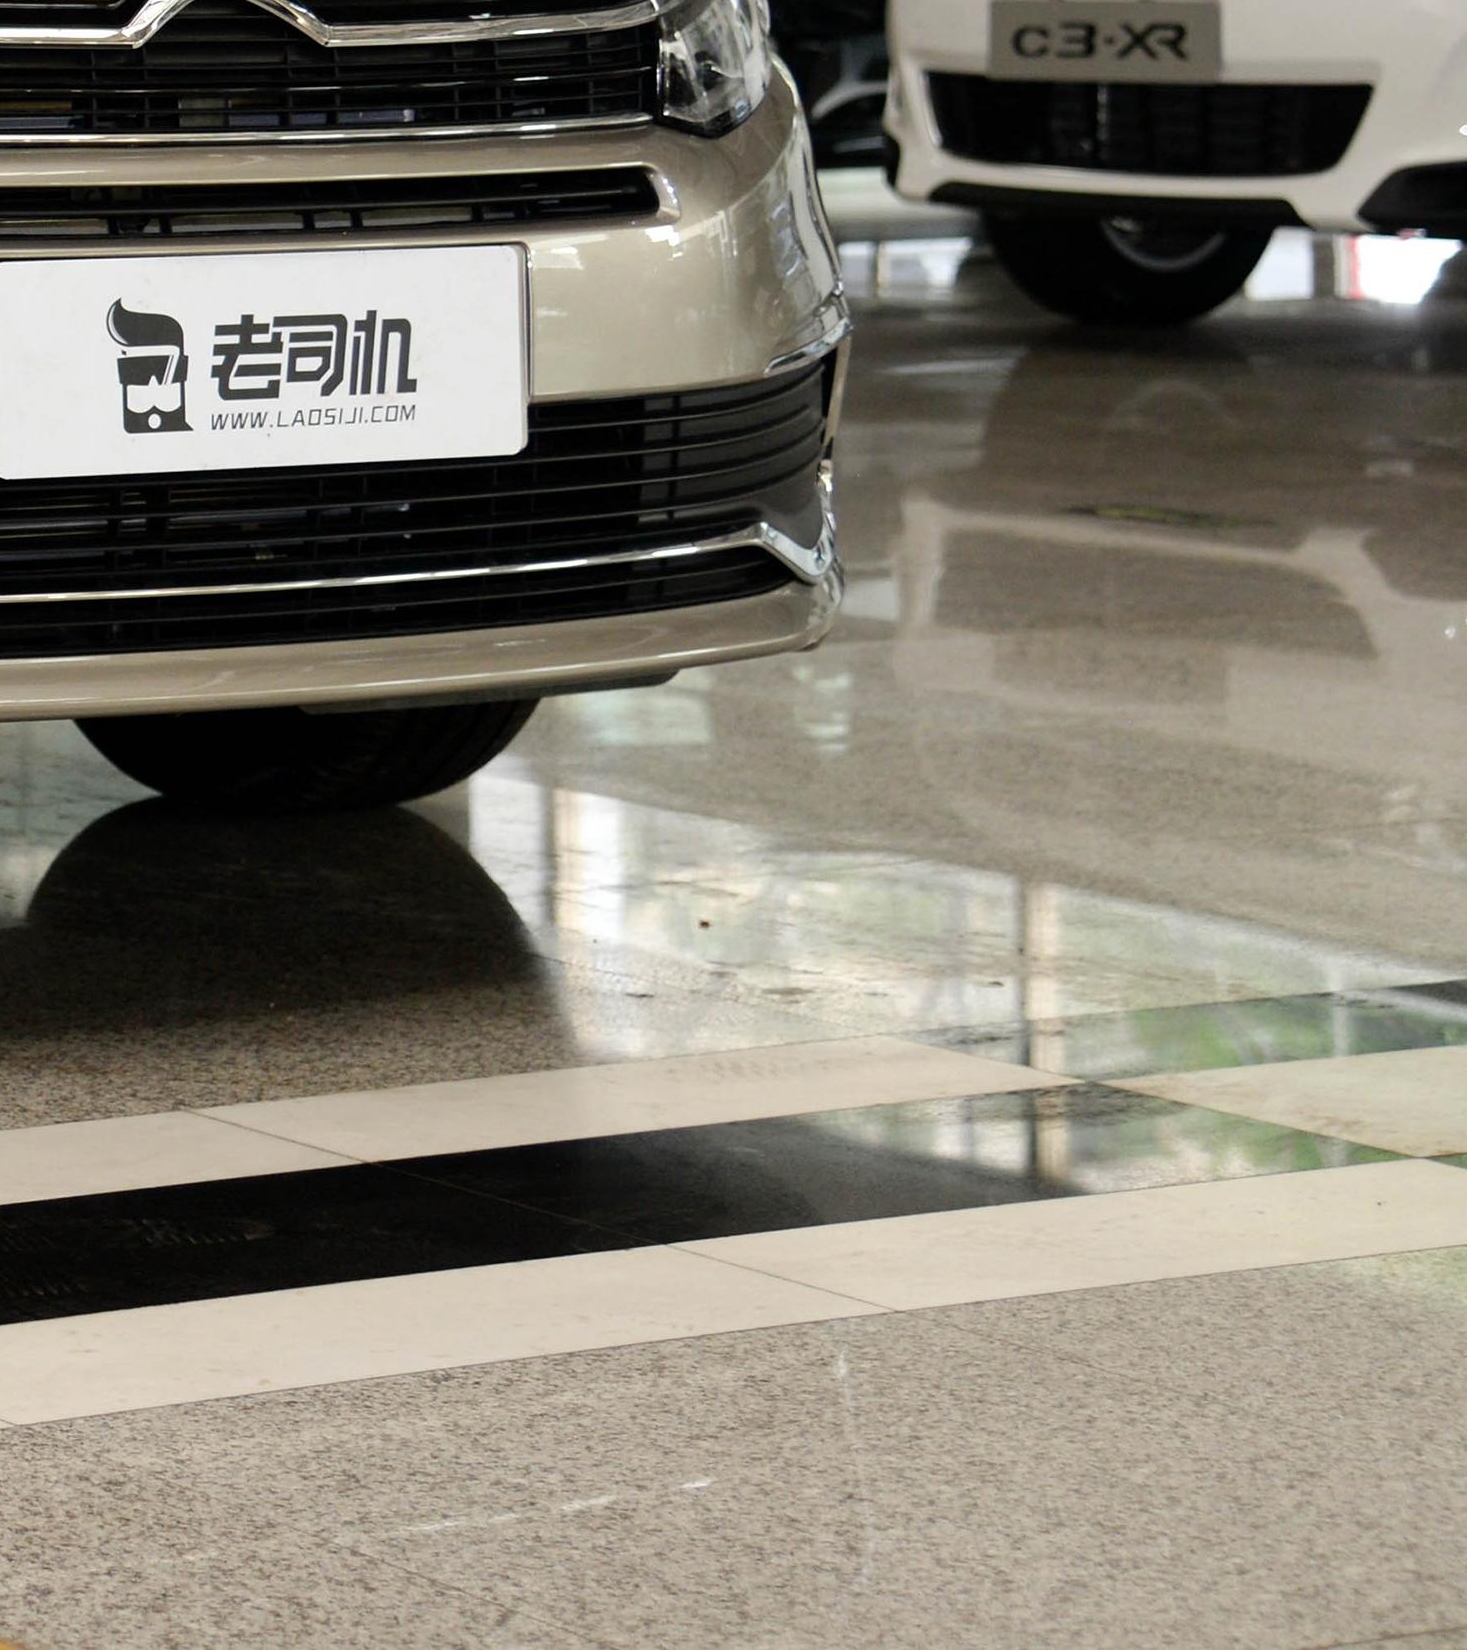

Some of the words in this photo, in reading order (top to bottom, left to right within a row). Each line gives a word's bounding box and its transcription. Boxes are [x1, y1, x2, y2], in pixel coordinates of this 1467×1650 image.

[211, 310, 417, 401] 老司机
[210, 404, 416, 431] WWW.LAOSIJI.COM
